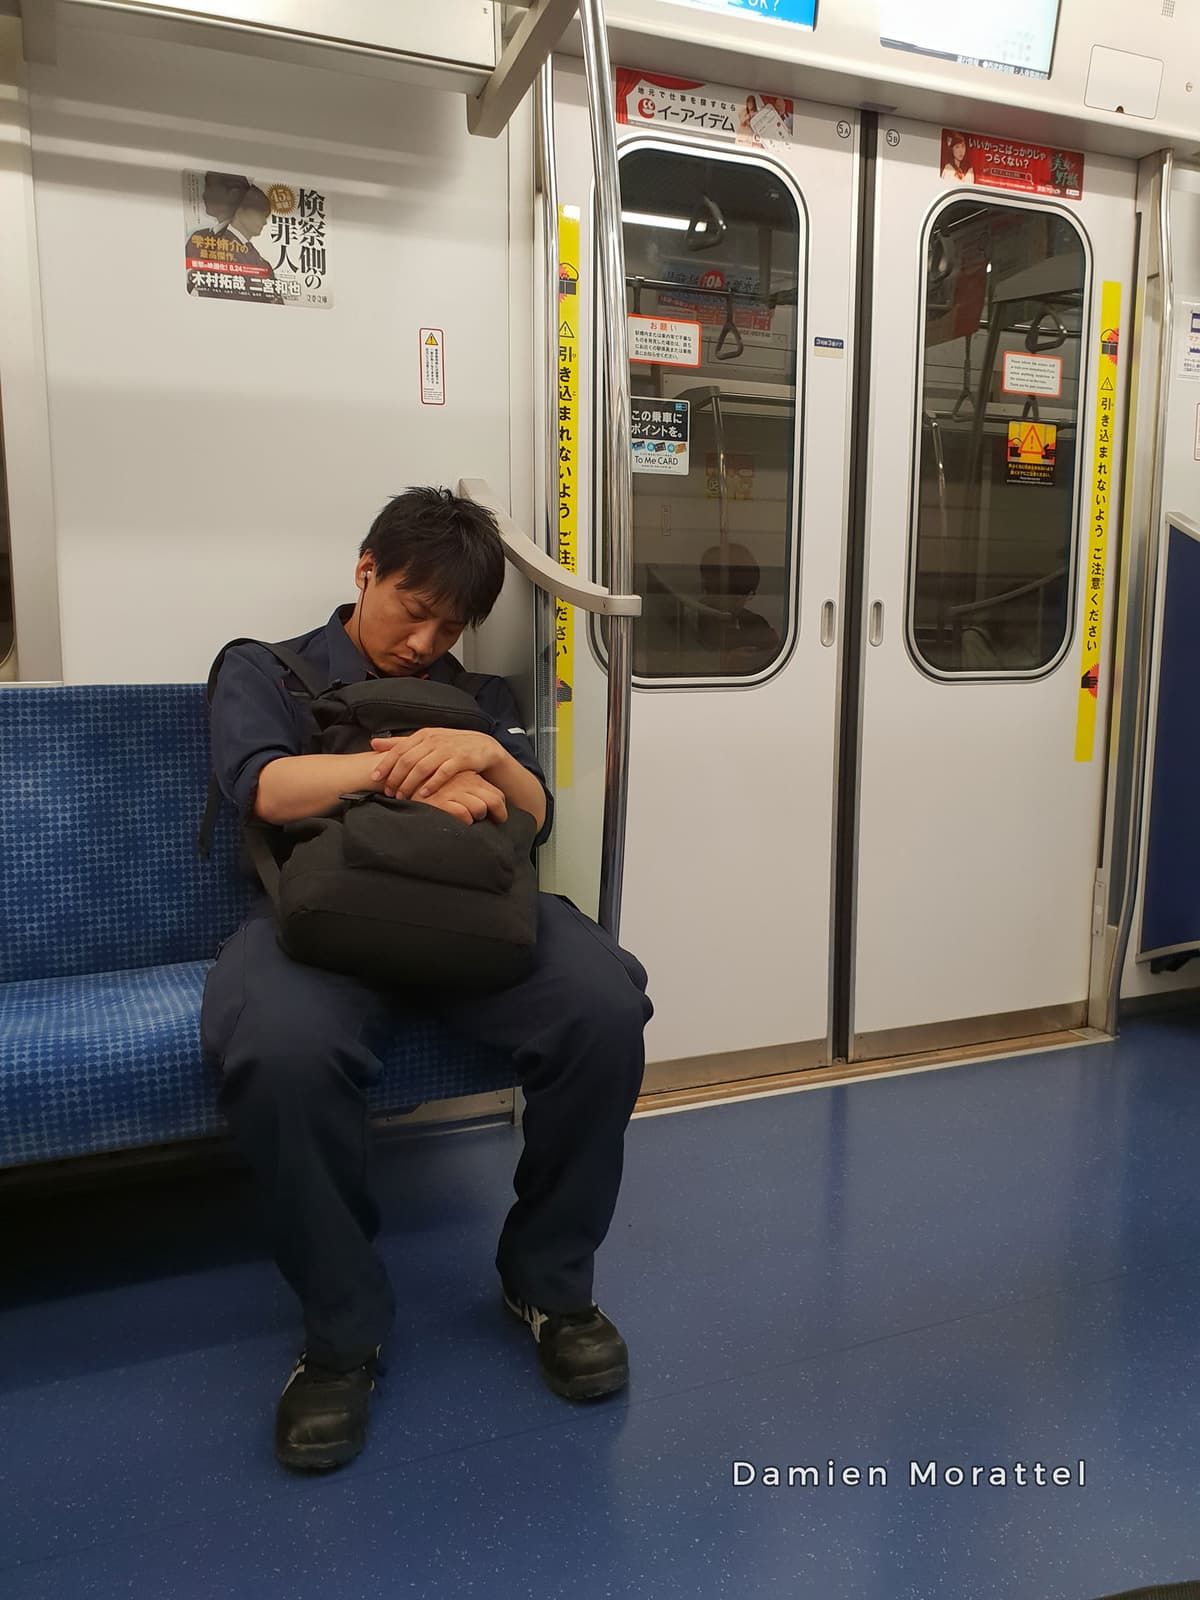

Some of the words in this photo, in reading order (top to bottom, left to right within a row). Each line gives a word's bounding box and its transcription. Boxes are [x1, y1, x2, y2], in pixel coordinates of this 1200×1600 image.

[657, 105, 736, 133] イーアイデム
[967, 138, 1047, 161] いいかっこばっかりじゃ
[270, 214, 299, 274] 罪人
[297, 187, 327, 290] 検察側の
[191, 271, 247, 291] 木村拓哉
[250, 277, 302, 297] 二宮和也
[631, 410, 683, 424] この乗車に
[631, 422, 683, 438] ポイントを。
[634, 456, 644, 465] To
[644, 456, 657, 465] Me
[657, 457, 679, 466] CARD
[1095, 397, 1111, 538] 引き込まれないよう
[1087, 547, 1104, 652] ご注意ください
